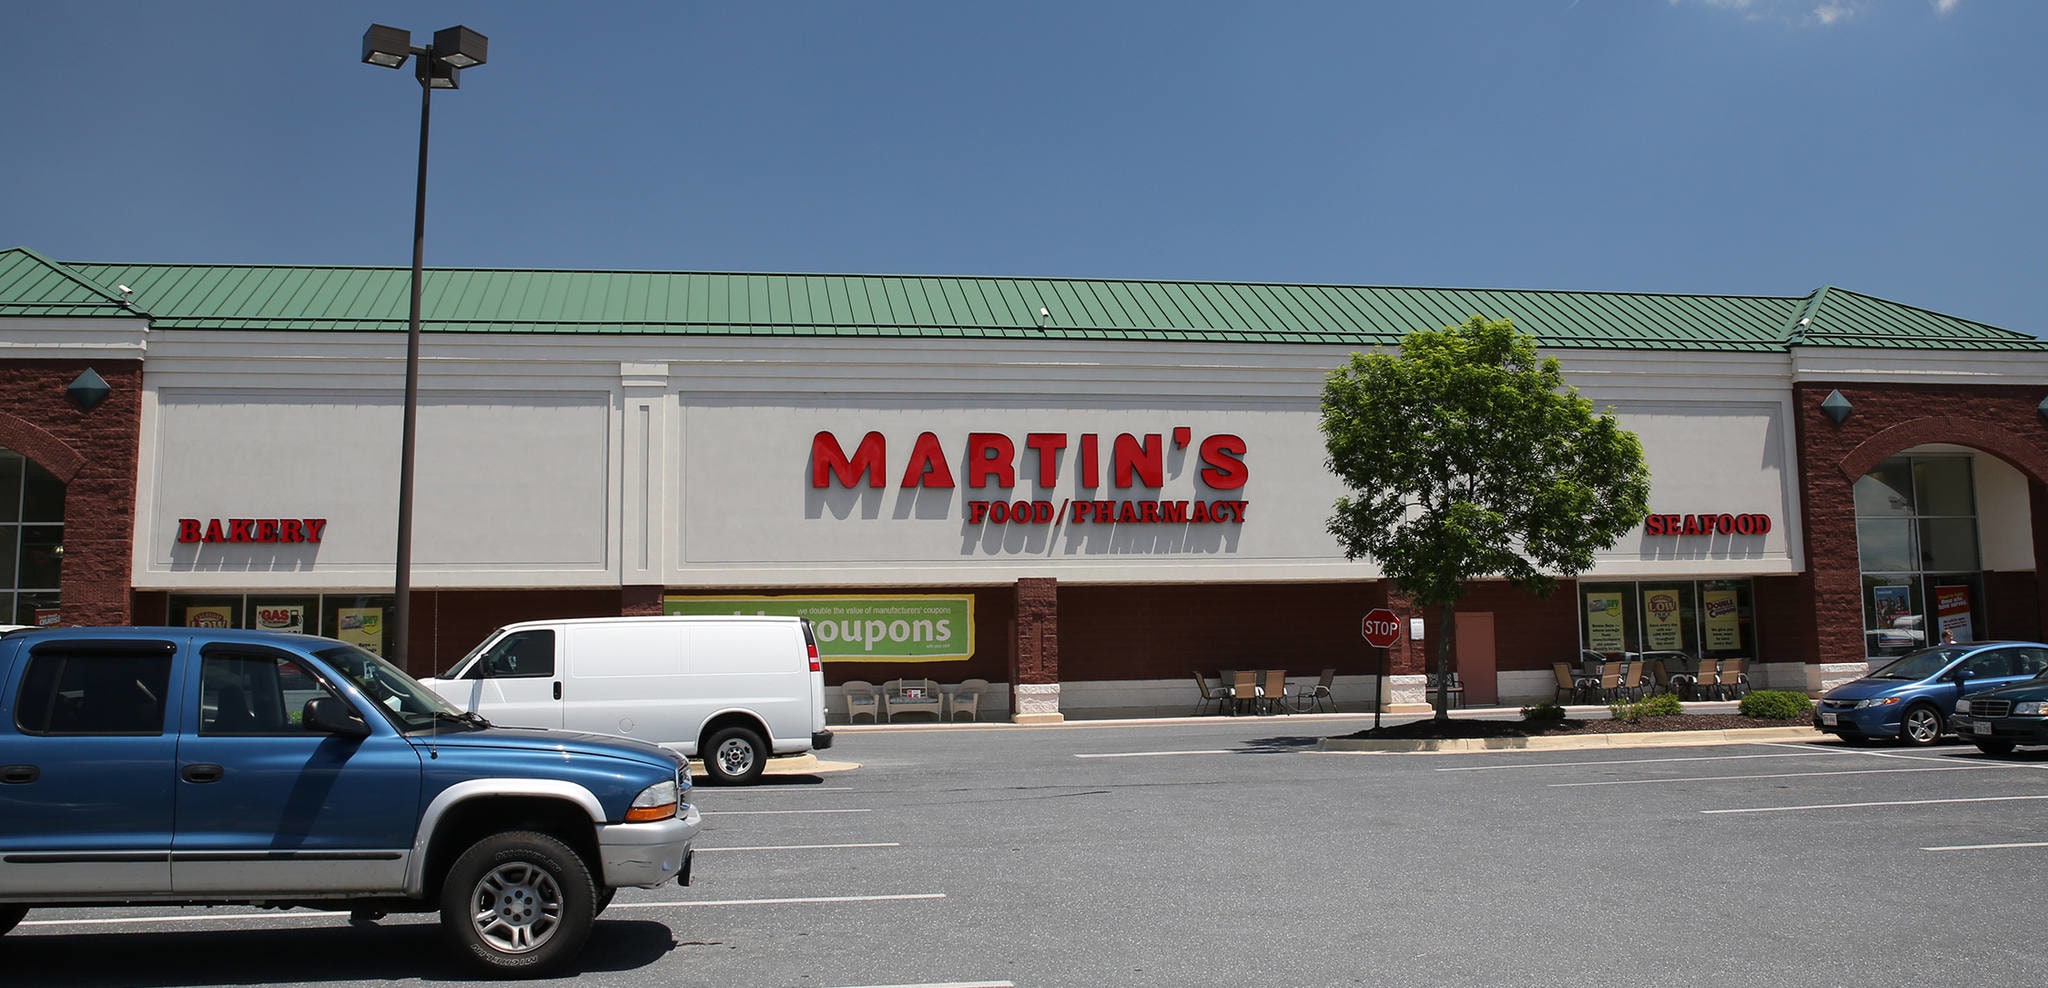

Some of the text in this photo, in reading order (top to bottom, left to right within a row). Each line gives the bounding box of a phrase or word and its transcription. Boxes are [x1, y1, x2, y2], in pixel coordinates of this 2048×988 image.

[812, 426, 1249, 490] MARTIN'S
[968, 498, 1249, 526] FOOD/PHARMACY
[178, 518, 327, 544] BAKERY
[1646, 513, 1772, 536] SEAFOOD
[261, 609, 289, 621] GAS
[809, 607, 832, 615] double
[833, 607, 845, 615] the
[846, 607, 863, 615] value
[864, 607, 872, 615] of
[924, 607, 951, 616] coupons
[811, 618, 951, 651] oupons
[1365, 620, 1398, 636] STOP
[470, 944, 538, 967] MICHELIN
